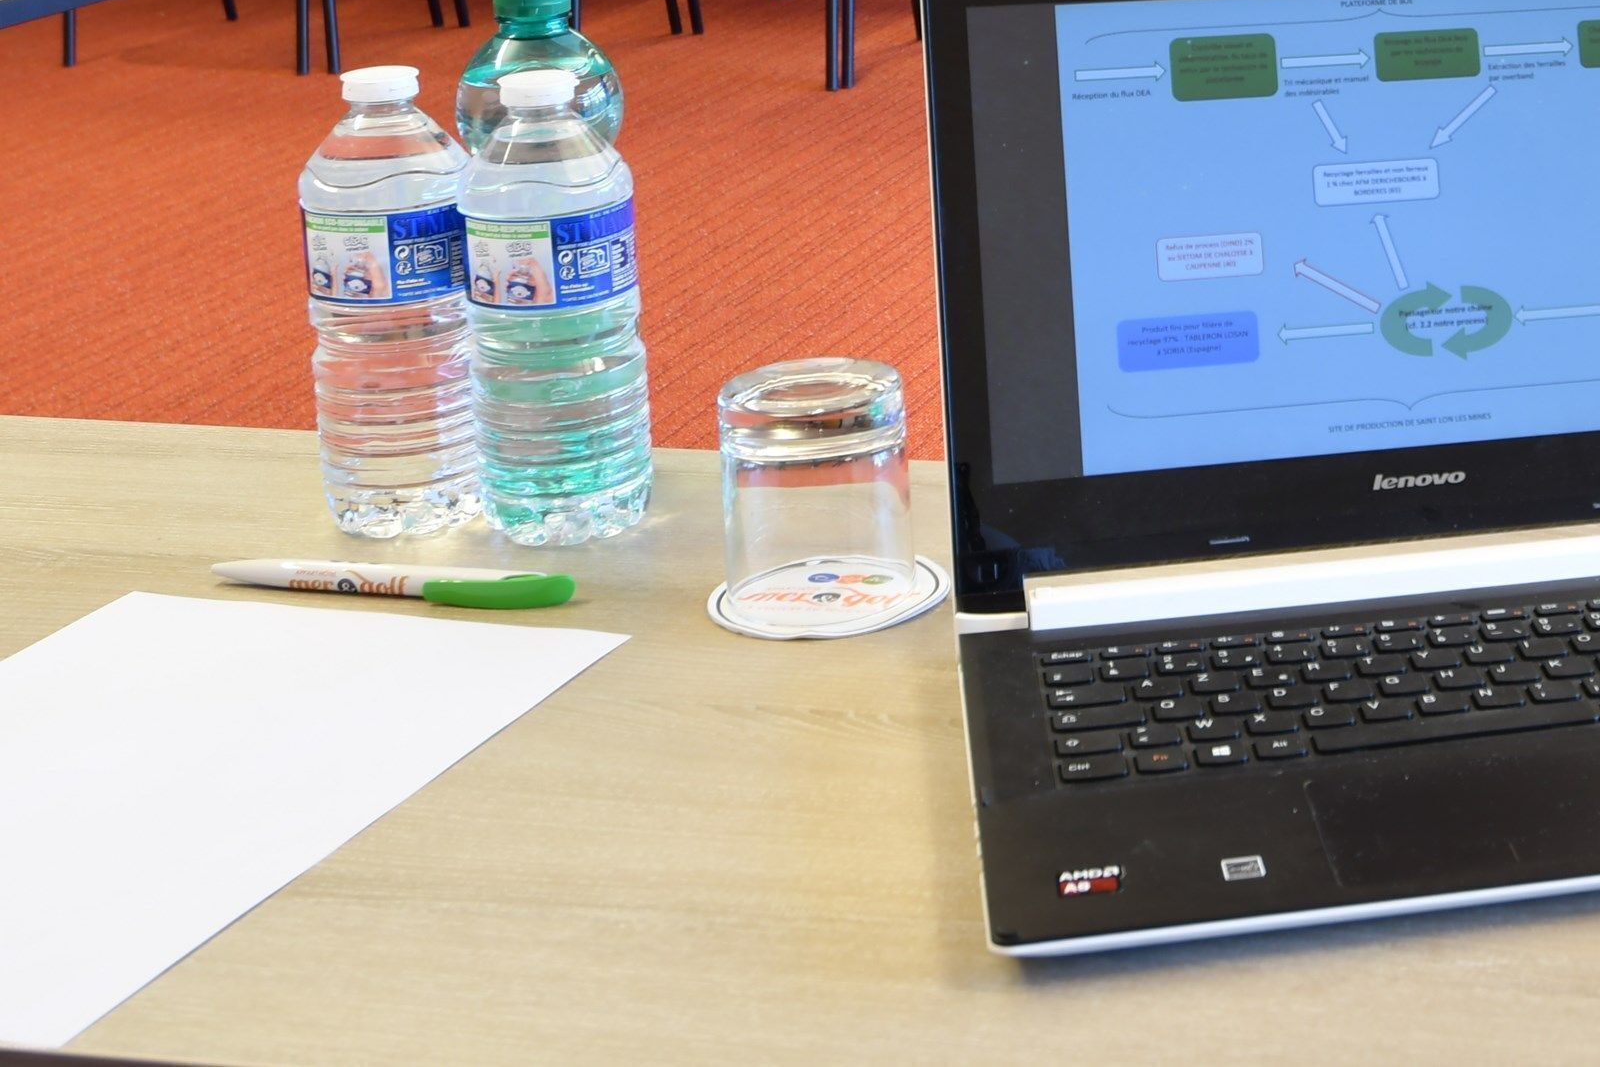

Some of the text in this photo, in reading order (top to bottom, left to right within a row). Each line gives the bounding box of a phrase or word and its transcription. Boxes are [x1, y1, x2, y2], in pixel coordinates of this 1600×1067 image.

[1523, 61, 1535, 69] des
[1284, 74, 1370, 87] Tri mécanique et manuel
[1488, 74, 1500, 83] par
[1071, 89, 1151, 102] Réception du flux DEA
[1284, 89, 1297, 97] des
[1328, 424, 1342, 433] SITE
[1344, 424, 1355, 432] DE
[1355, 420, 1404, 431] PRODUCTION
[1404, 419, 1415, 427] DE
[1416, 417, 1438, 427] SAINT
[1454, 414, 1467, 423] LES
[1372, 470, 1466, 492] lenovo
[1548, 658, 1563, 669] K
[1252, 667, 1264, 677] E
[1440, 669, 1455, 679] H
[1478, 687, 1493, 698] N
[1366, 699, 1380, 710] V
[1253, 712, 1267, 723] X
[1195, 718, 1213, 730] W
[1272, 740, 1289, 750] Alt
